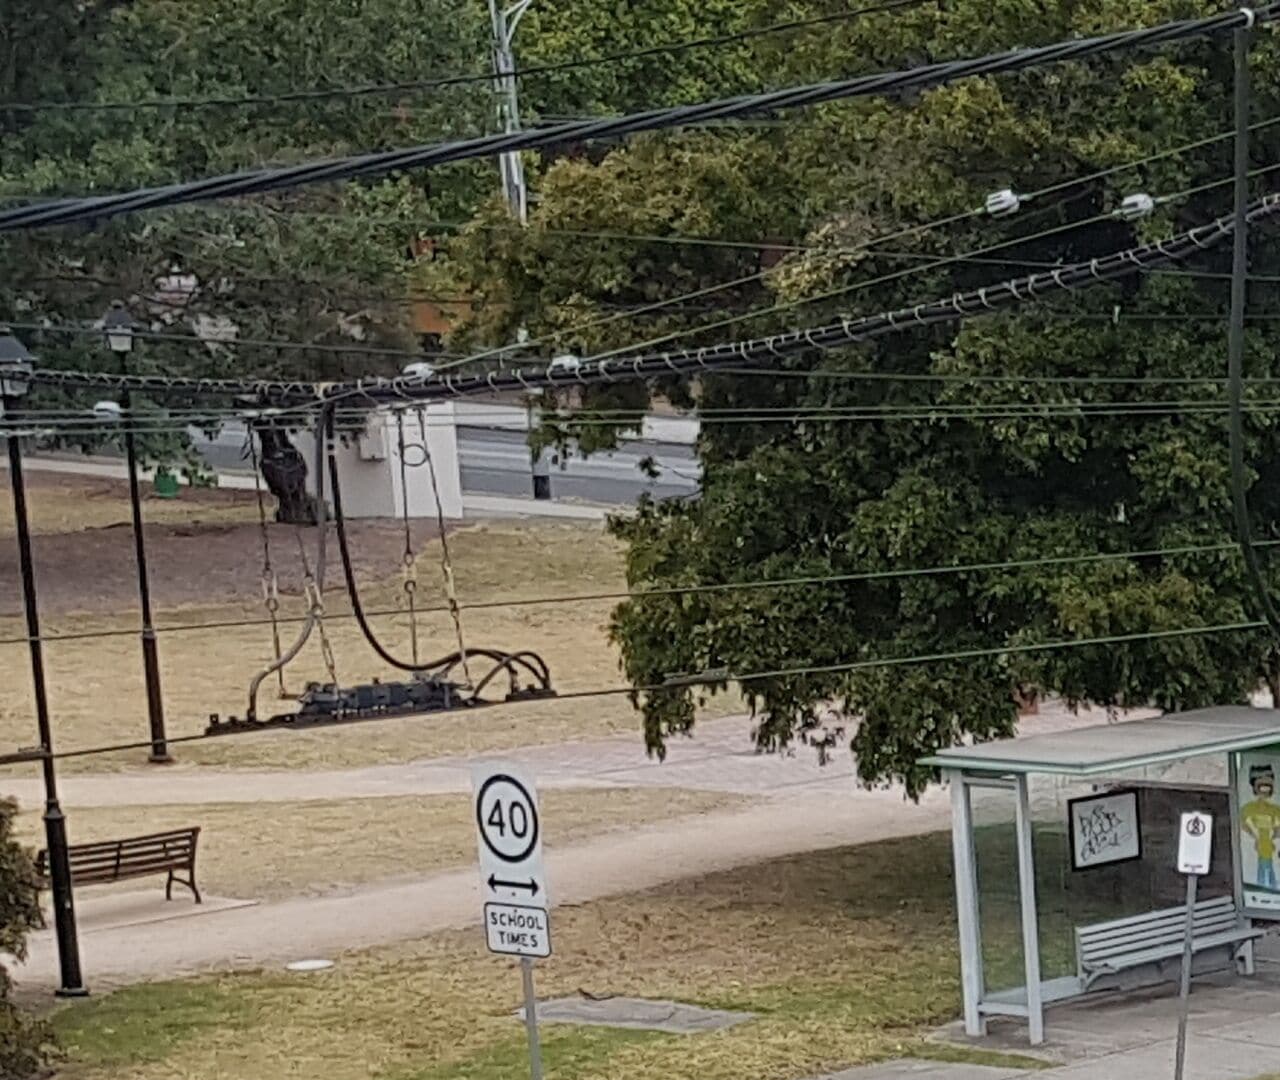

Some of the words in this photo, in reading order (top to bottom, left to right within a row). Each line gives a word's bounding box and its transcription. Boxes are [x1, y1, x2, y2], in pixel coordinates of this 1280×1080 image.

[487, 798, 528, 839] 40
[490, 911, 544, 931] SCHOOL
[497, 930, 539, 948] TIMES
